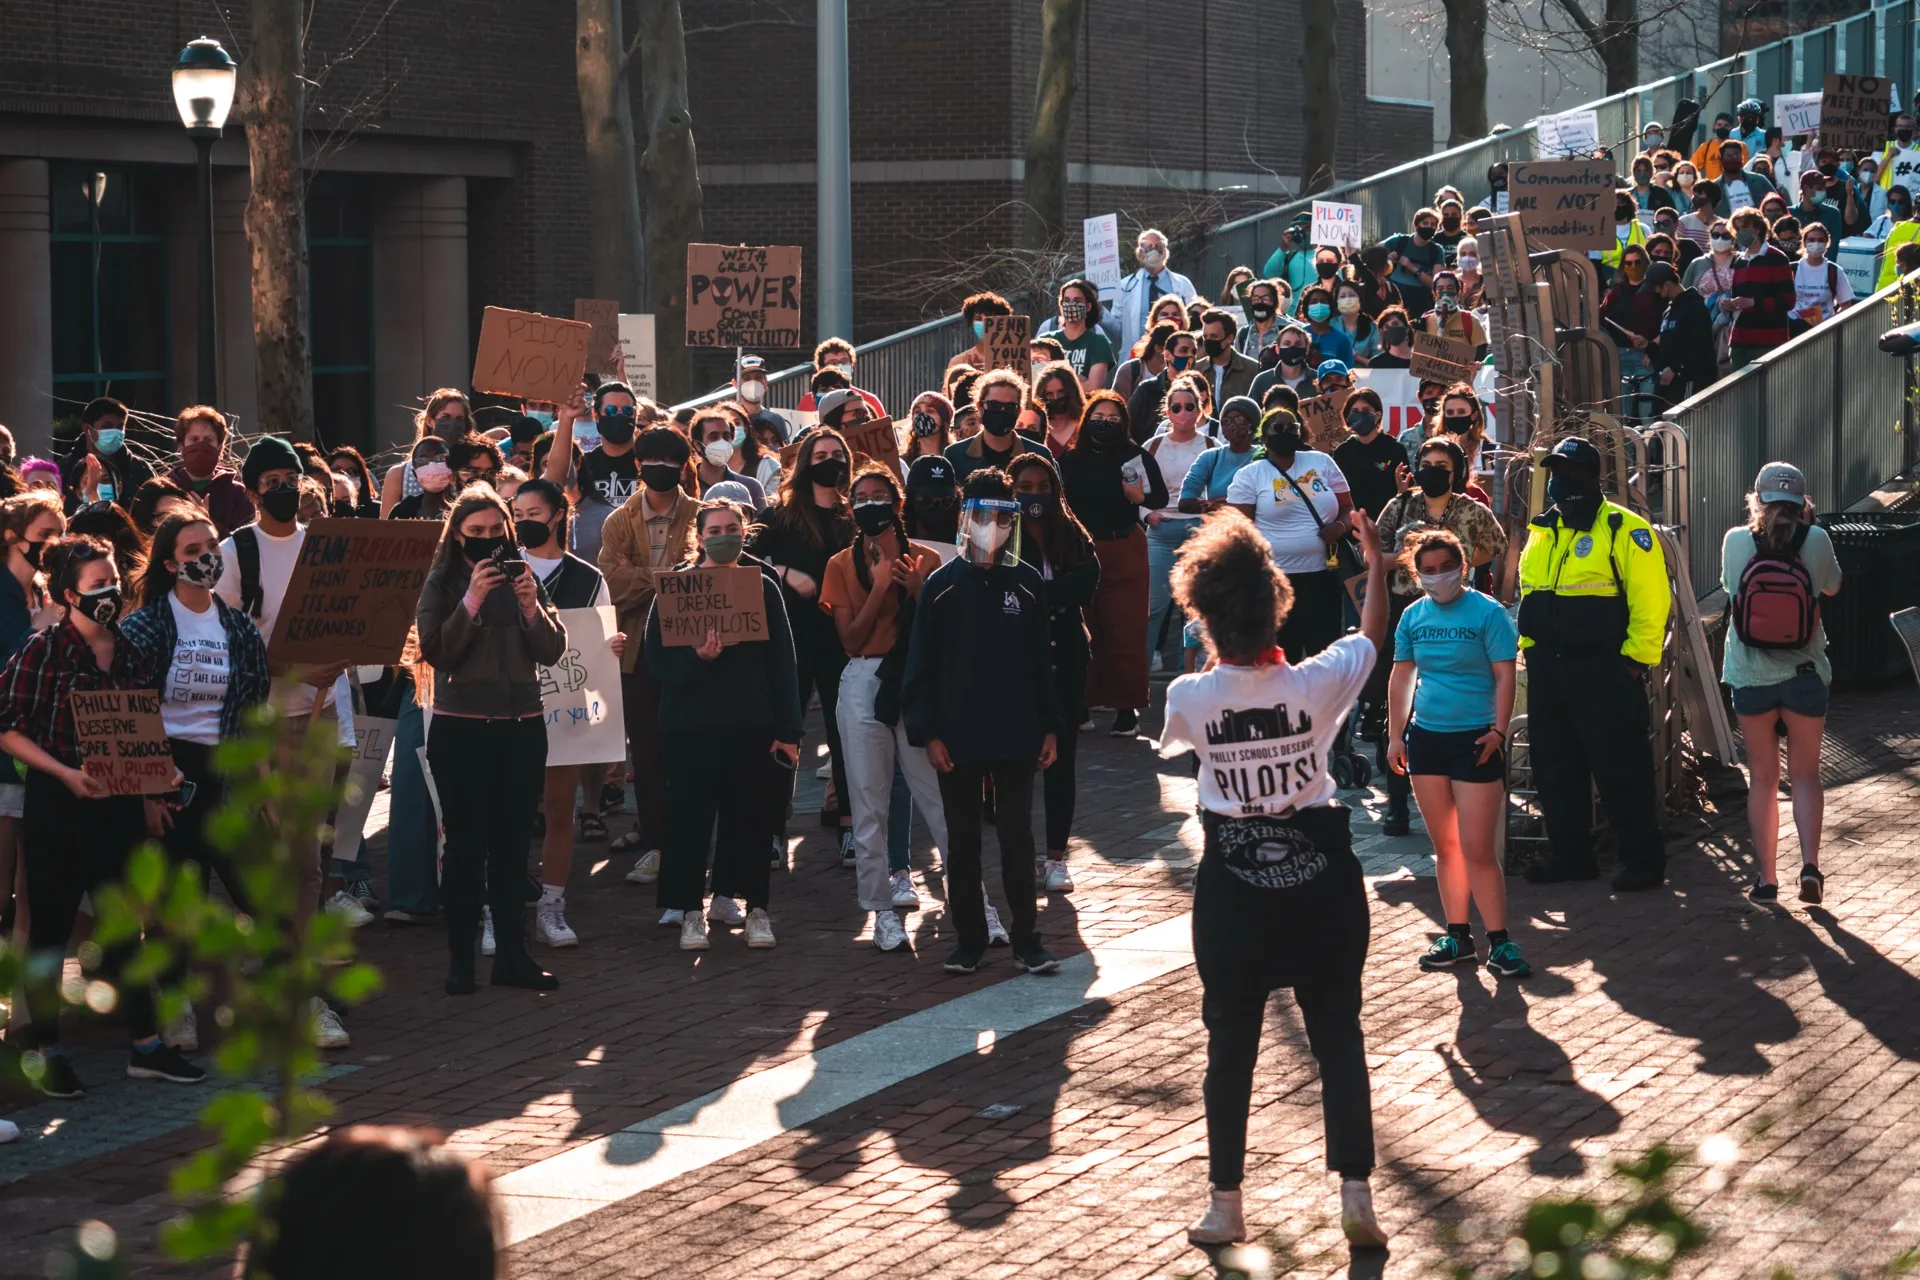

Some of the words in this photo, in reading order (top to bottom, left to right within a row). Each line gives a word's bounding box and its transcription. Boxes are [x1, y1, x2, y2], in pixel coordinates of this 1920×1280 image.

[1838, 75, 1880, 94] NO
[1515, 166, 1613, 188] Communities
[1514, 195, 1538, 210] ARE
[1556, 193, 1600, 211] NOT
[722, 249, 767, 262] WITH
[718, 262, 768, 273] GREAT
[722, 307, 766, 320] COMES
[717, 319, 766, 331] GREAT
[985, 318, 1026, 333] PENN
[990, 332, 1026, 346] PAY
[1420, 334, 1449, 352] FUND
[991, 347, 1026, 360] YOUR
[492, 350, 578, 386] NOW
[1301, 398, 1334, 417] TAX
[359, 568, 424, 590] STOPPED
[661, 575, 703, 594] PENN
[324, 595, 359, 613] JUST
[677, 594, 733, 613] DREXEL
[285, 616, 366, 643] REBRANDED
[663, 611, 761, 636] #PAYPILOTS
[195, 653, 212, 665] CLEAN
[213, 657, 223, 666] AIR
[194, 673, 209, 684] SAFE
[72, 694, 121, 716] PHILLY
[127, 694, 160, 714] KIDS
[79, 718, 138, 737] DESERVE
[80, 740, 110, 757] SAFE
[117, 740, 171, 758] SCHOOLS
[1209, 751, 1236, 763] PHILLY
[1239, 746, 1279, 762] SCHOOLS
[1281, 736, 1315, 756] DESERVE
[86, 761, 115, 777] PAY
[123, 760, 168, 777] PILOTS
[1213, 752, 1318, 803] PILOTS!
[106, 776, 141, 794] NOW
